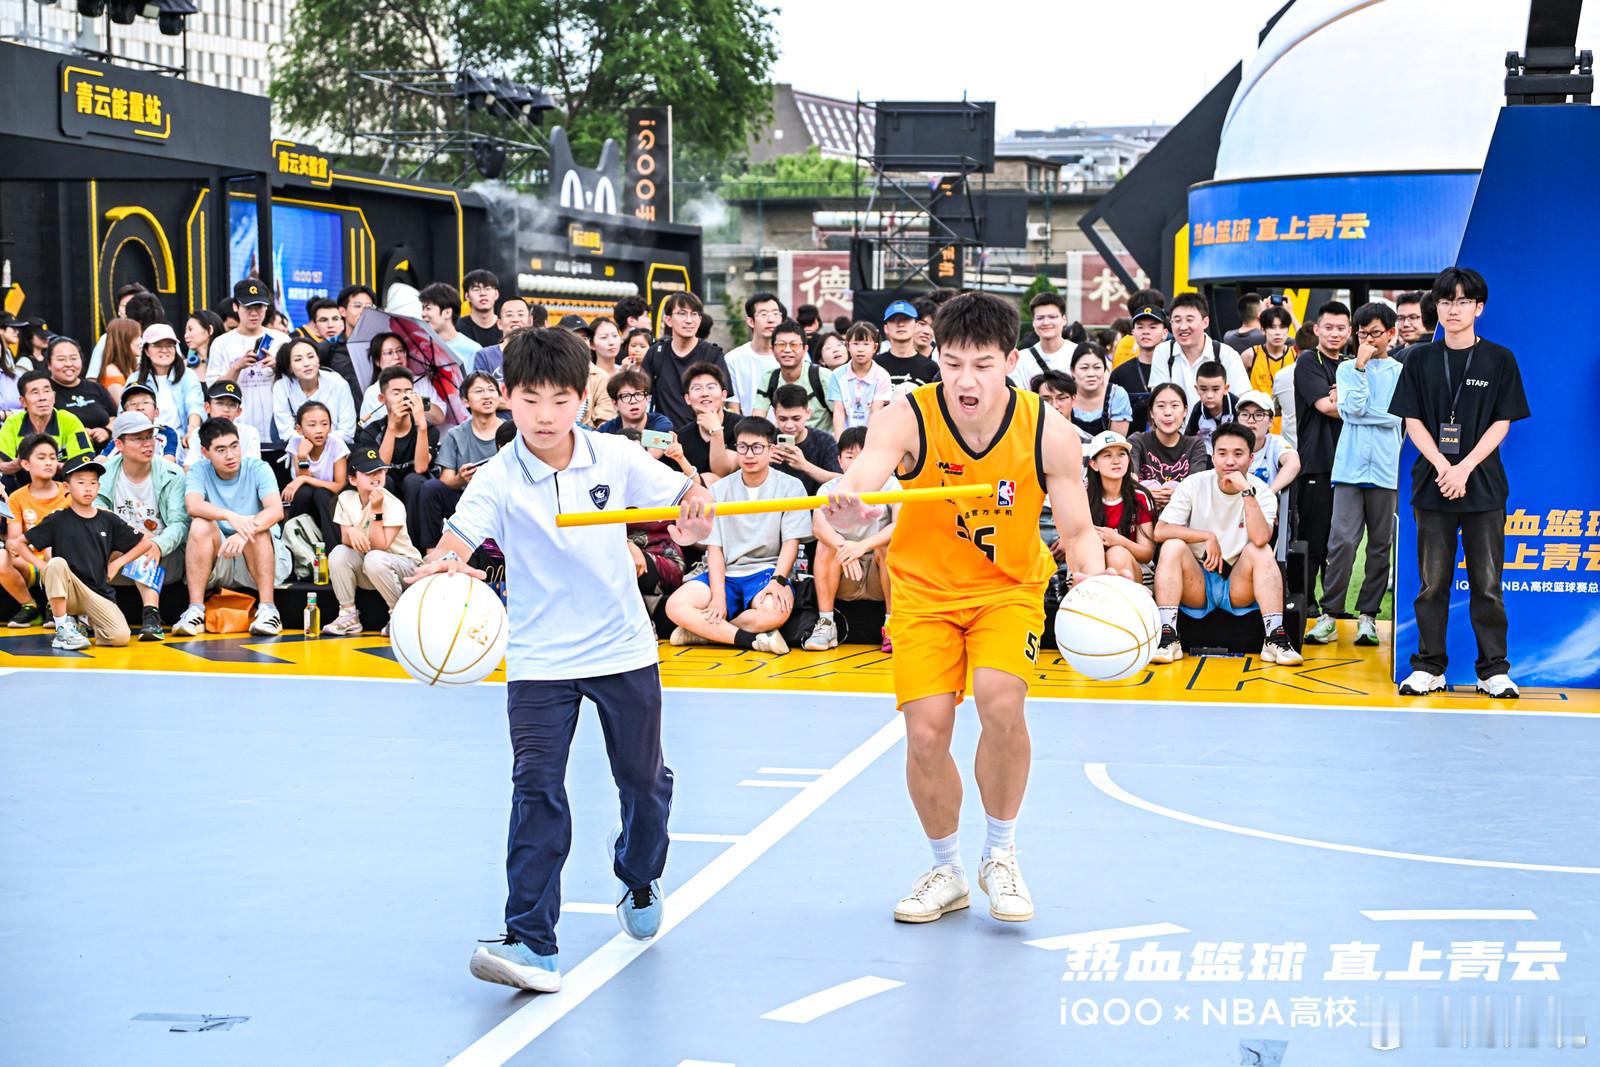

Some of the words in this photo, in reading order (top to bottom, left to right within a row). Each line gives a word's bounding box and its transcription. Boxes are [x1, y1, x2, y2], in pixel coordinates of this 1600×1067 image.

[75, 81, 161, 126] 青云能量站
[1256, 213, 1370, 241] 直上青云
[799, 265, 853, 309] 德
[1466, 378, 1489, 388] STAFF
[1458, 508, 1600, 537] 血篮
[1457, 543, 1600, 571] 上青
[1455, 580, 1470, 590] iQ
[1501, 581, 1599, 593] NBA高校篮球赛总
[1025, 630, 1040, 664] 5
